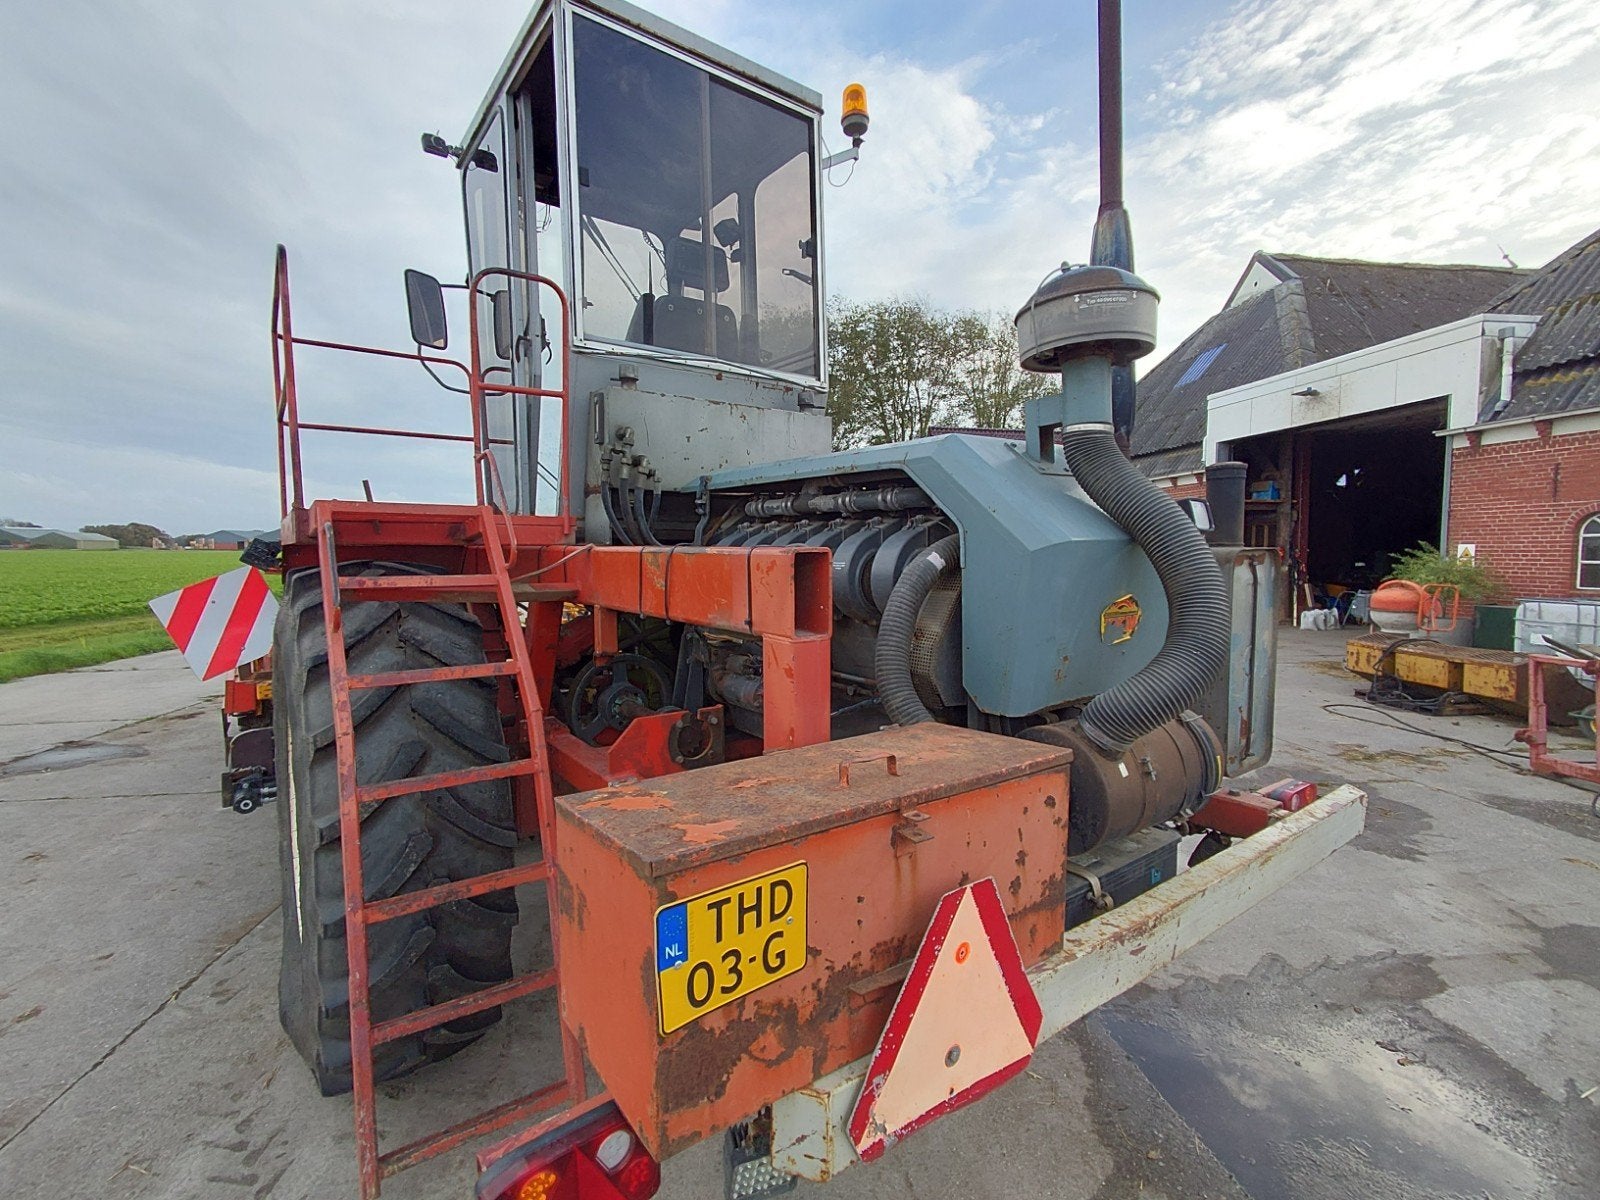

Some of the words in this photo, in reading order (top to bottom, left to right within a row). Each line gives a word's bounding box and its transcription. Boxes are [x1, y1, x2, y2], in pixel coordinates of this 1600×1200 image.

[707, 879, 793, 943] THD
[665, 943, 682, 959] NL
[687, 931, 786, 1008] 03-G
